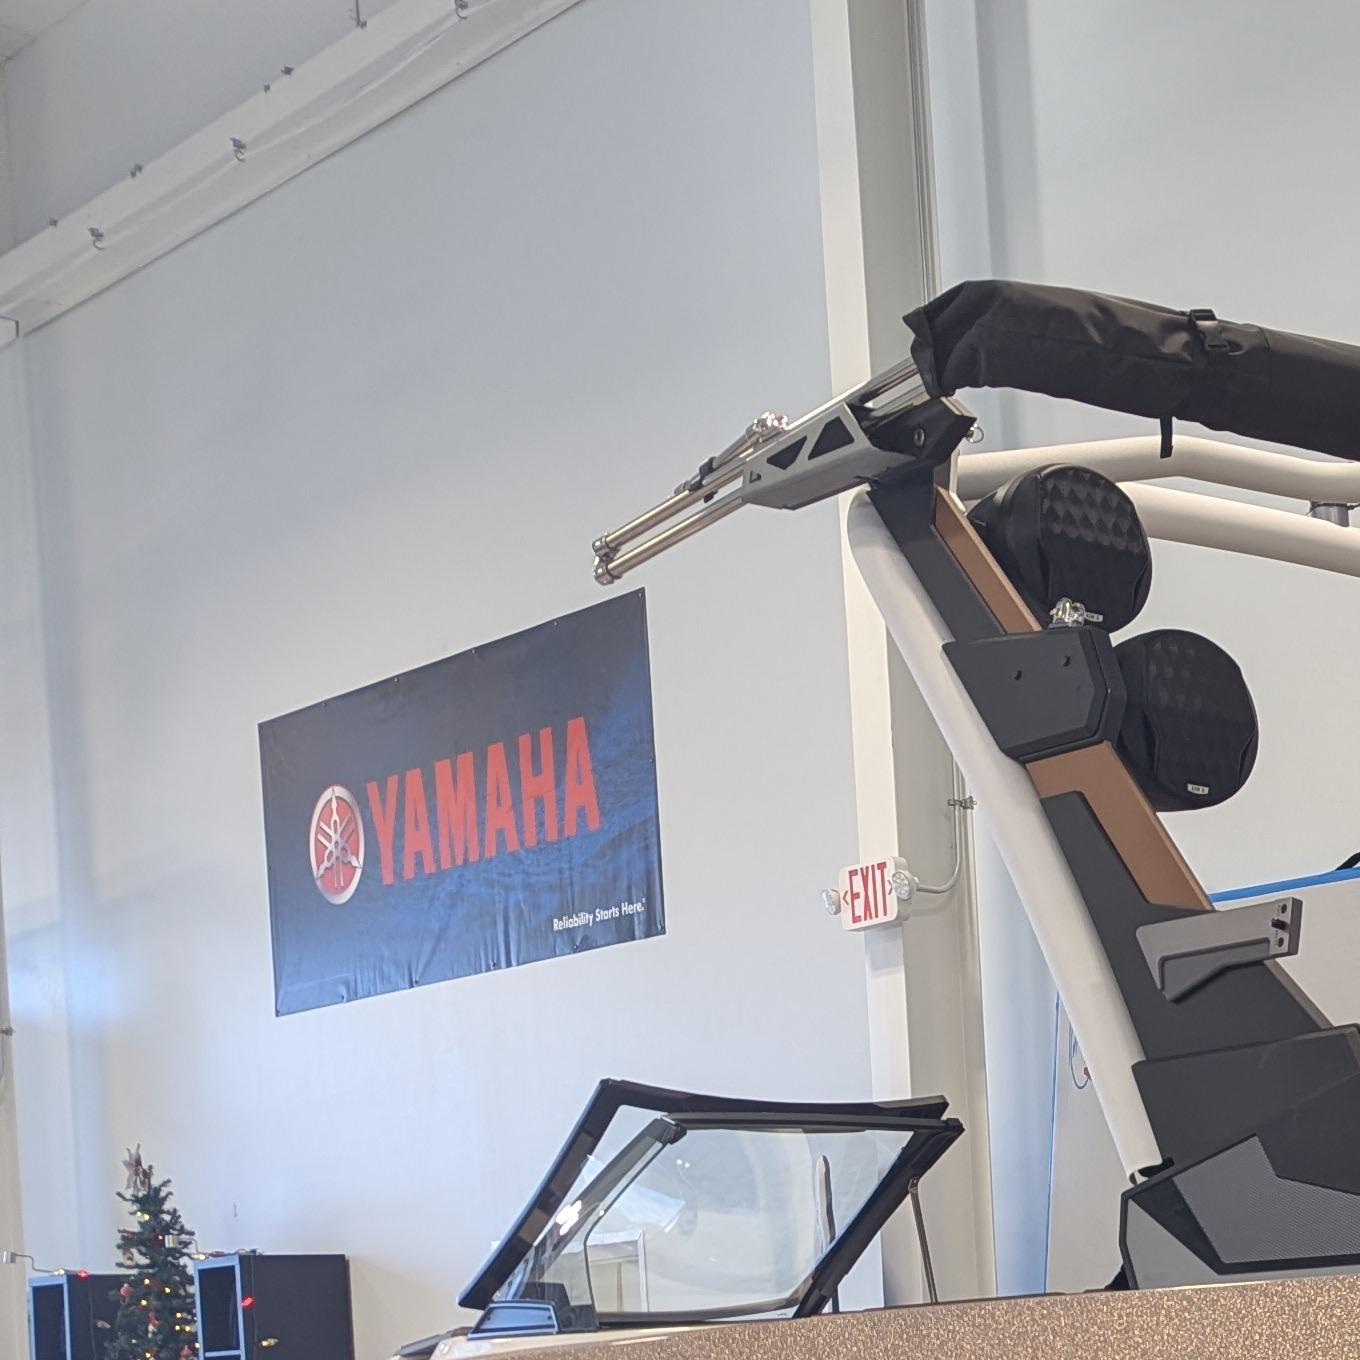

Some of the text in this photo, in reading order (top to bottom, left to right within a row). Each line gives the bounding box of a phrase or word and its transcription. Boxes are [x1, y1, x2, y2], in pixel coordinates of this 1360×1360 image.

[366, 716, 601, 885] YAMAHA
[553, 911, 594, 931] Reliability
[595, 906, 620, 922] Starts
[848, 861, 888, 924] EXIT
